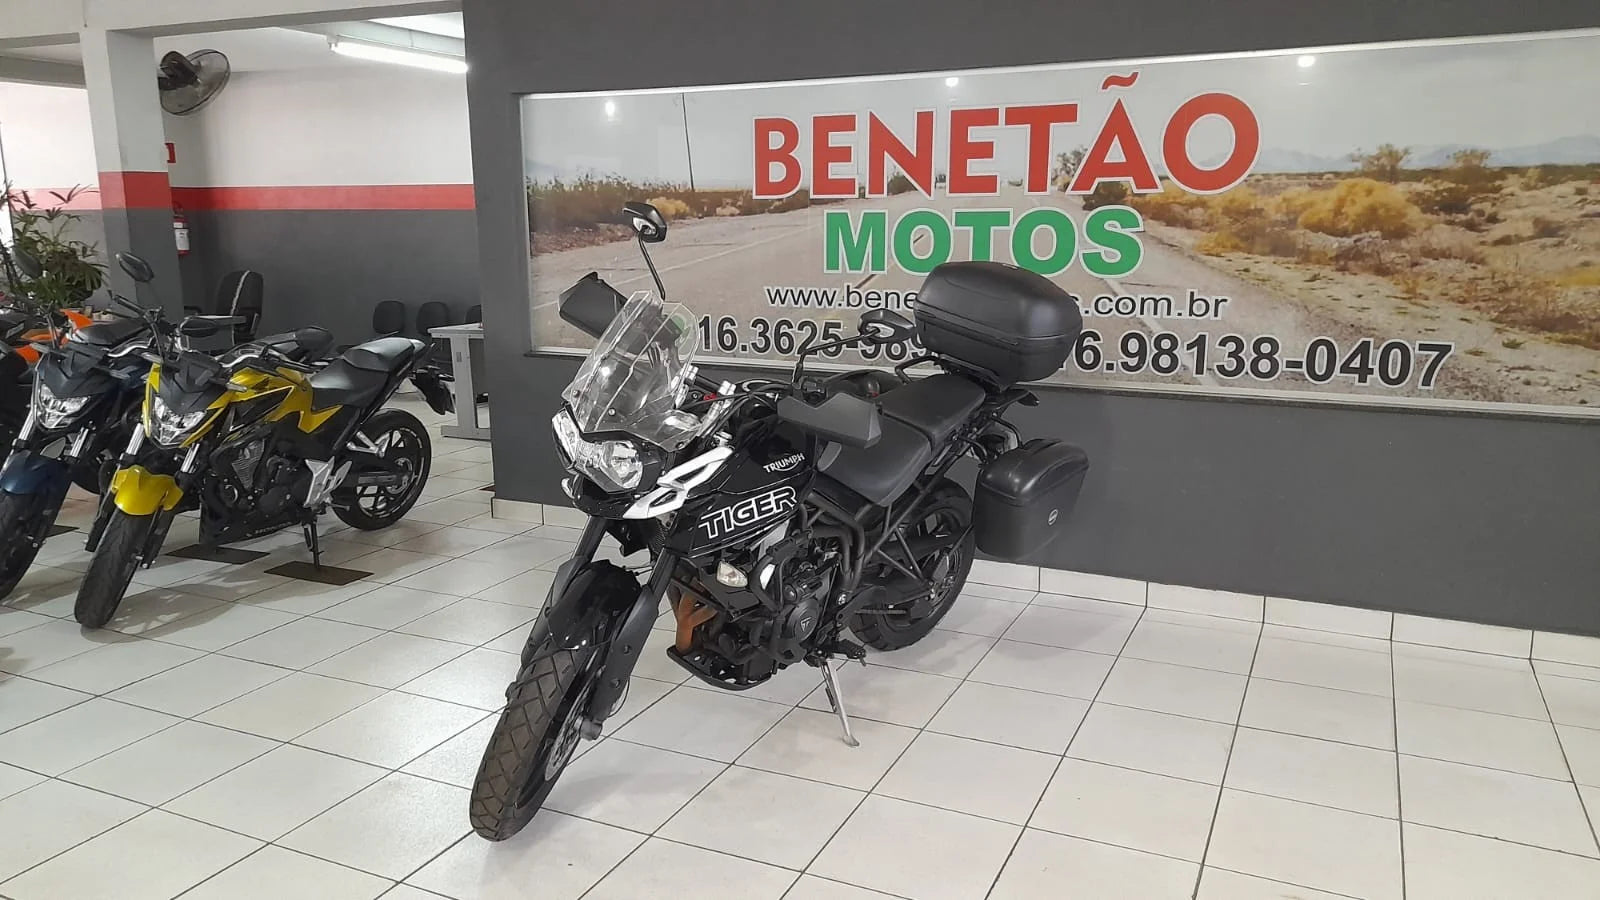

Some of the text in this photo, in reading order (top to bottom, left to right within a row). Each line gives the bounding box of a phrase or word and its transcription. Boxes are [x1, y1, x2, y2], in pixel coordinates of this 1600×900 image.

[753, 71, 1260, 197] BENETÃO
[825, 206, 1143, 275] MOTOS
[1059, 330, 1453, 387] 6.98138-0407
[763, 452, 806, 473] TRIUMPH
[698, 485, 798, 539] TIGER
